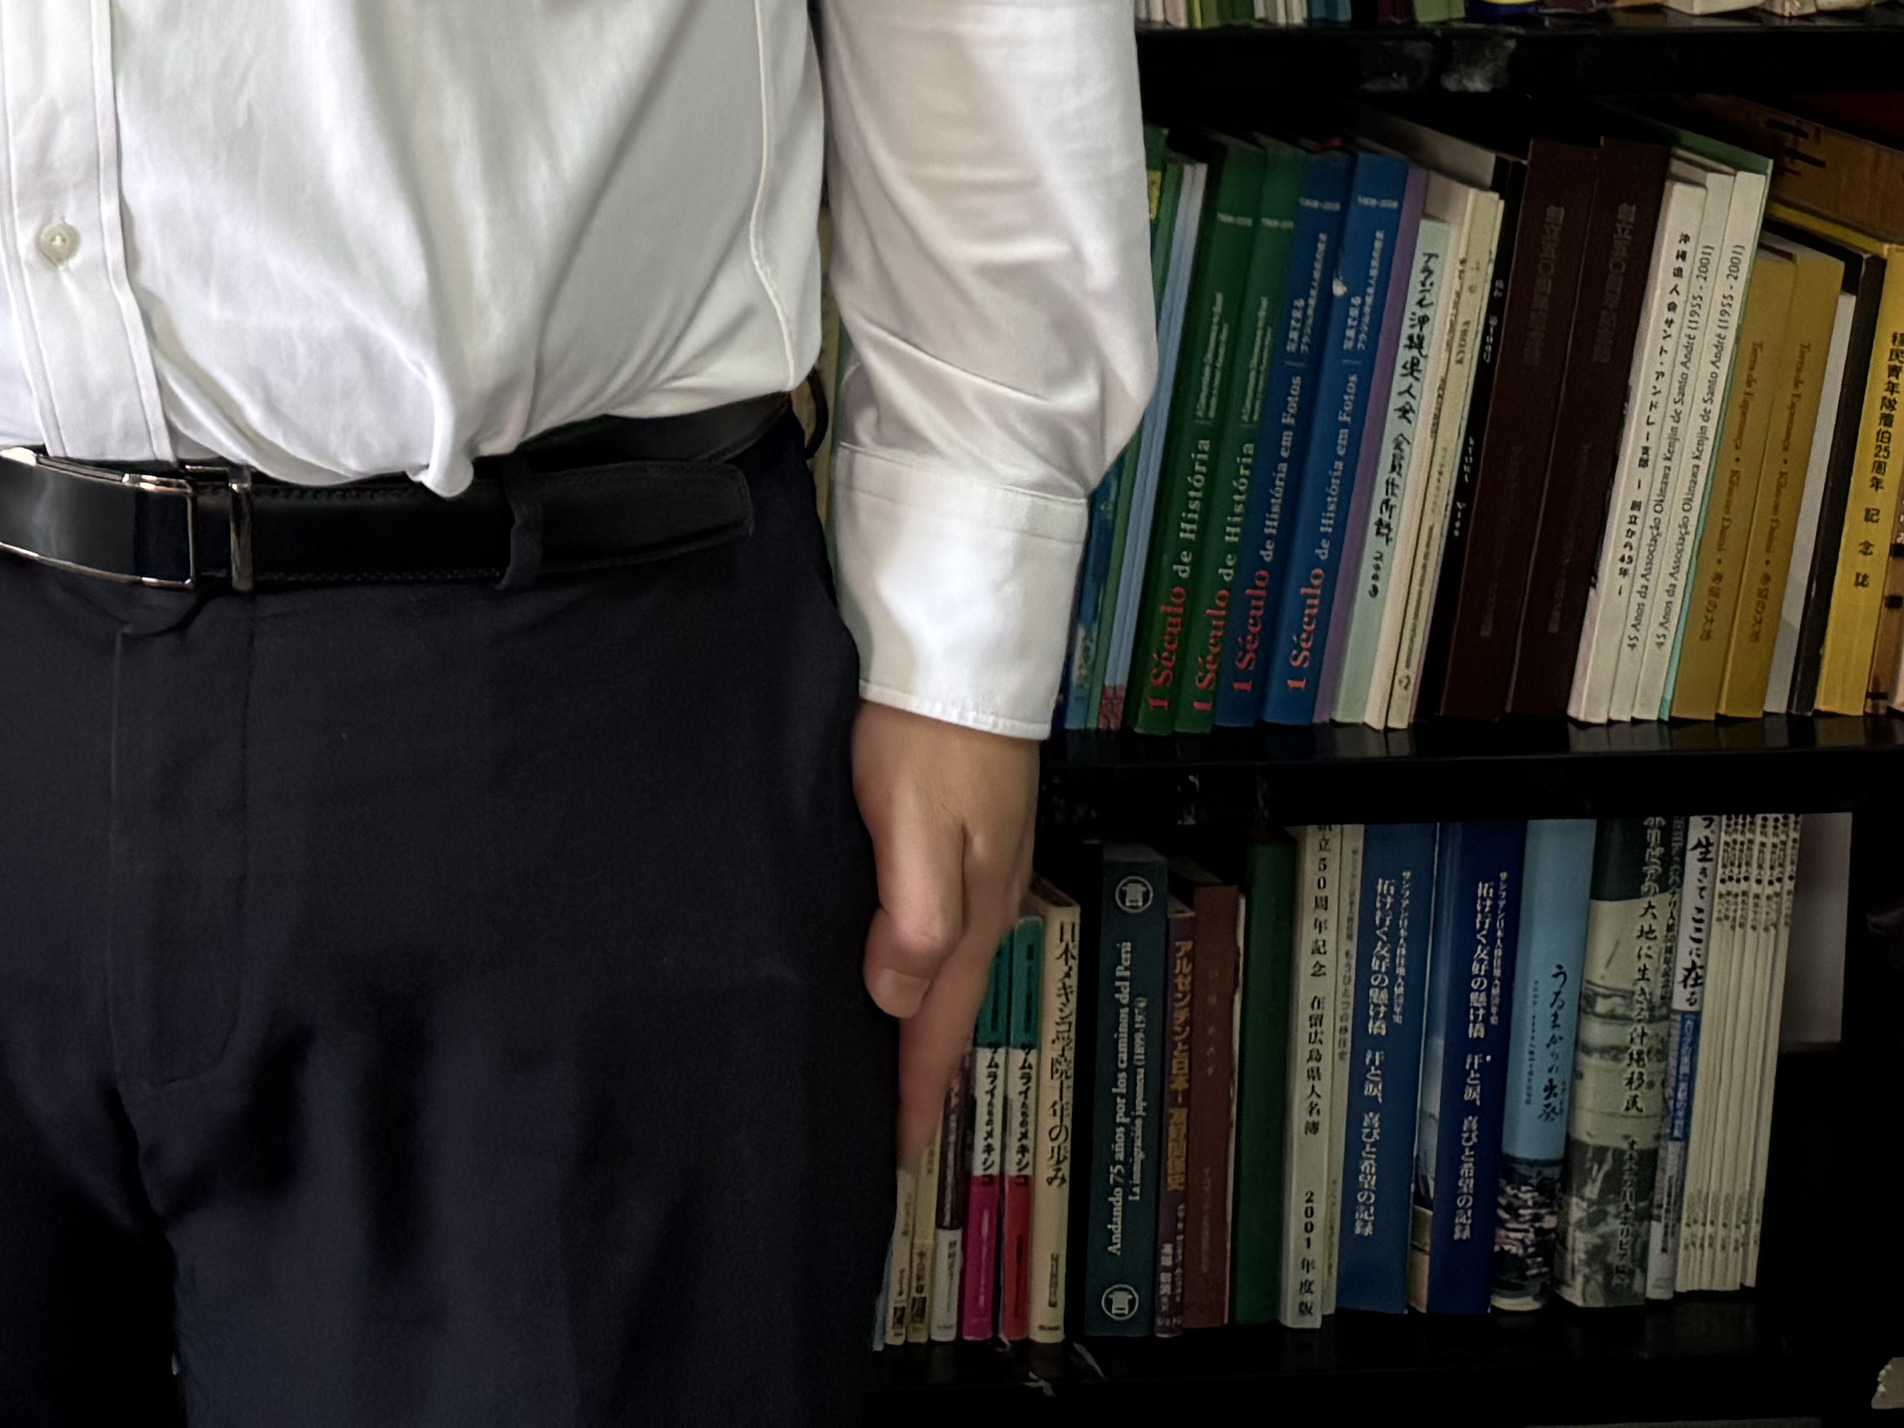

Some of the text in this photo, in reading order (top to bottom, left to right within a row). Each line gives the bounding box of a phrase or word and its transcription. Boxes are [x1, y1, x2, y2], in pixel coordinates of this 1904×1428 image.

[1149, 584, 1188, 688] Século
[1178, 438, 1211, 540] História
[1194, 588, 1232, 688] Século
[1223, 441, 1257, 543] História
[1236, 568, 1271, 671] Século
[1265, 461, 1292, 530] História
[1281, 375, 1302, 426] Fotos
[1290, 565, 1324, 671] Século
[1318, 458, 1347, 528] História
[1338, 373, 1358, 424] Fotos
[1114, 982, 1131, 1006] del
[1368, 878, 1395, 1037] 拓け行く友好の懸け橋
[1467, 881, 1495, 1040] 拓け行く友好の懸け橋
[1112, 1076, 1128, 1095] los
[1117, 1008, 1130, 1075] caminos
[1302, 995, 1326, 1137] 在留広島県人名簿
[1110, 1162, 1125, 1186] 75
[1112, 1128, 1126, 1162] años
[1115, 1096, 1130, 1127] por
[1106, 1187, 1123, 1256] Andando
[1353, 1112, 1381, 1237] 喜びと希望の記録
[1453, 1115, 1479, 1241] 喜びと希望の記録
